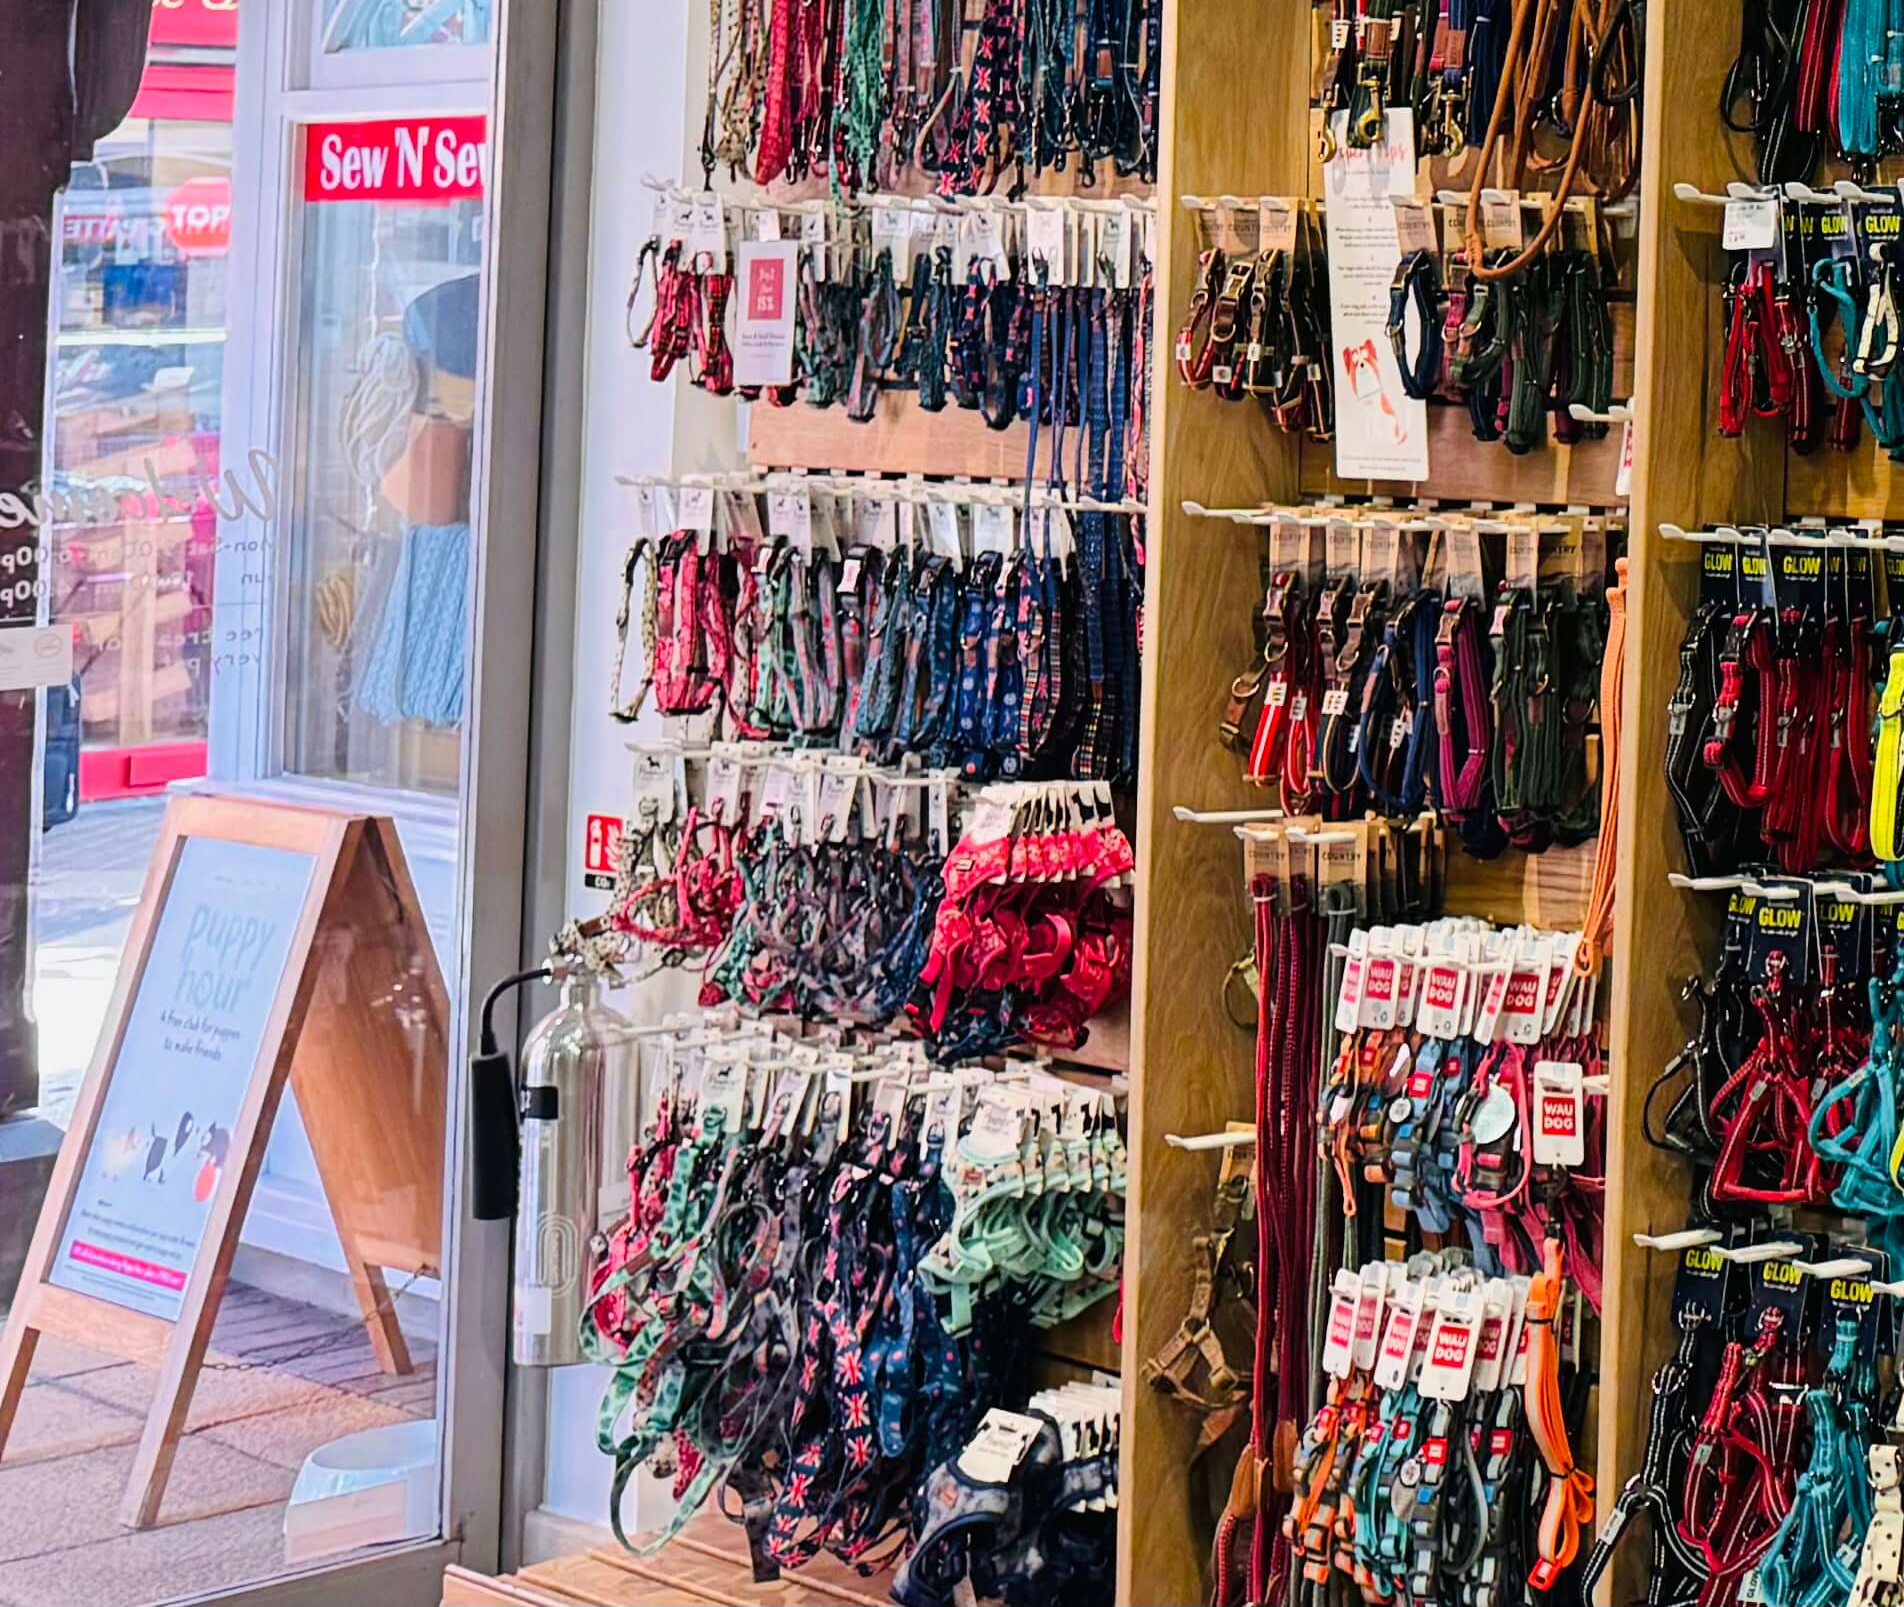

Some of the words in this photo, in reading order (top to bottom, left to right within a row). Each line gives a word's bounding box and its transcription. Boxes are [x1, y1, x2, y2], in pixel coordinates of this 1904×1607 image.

[321, 134, 390, 190] Sew
[1865, 216, 1901, 233] GLOW
[1704, 554, 1733, 571] GLOW
[1783, 556, 1822, 574] GLOW
[1758, 907, 1801, 927] GLOW
[181, 904, 277, 973] puppy
[175, 947, 252, 1012] hour
[1543, 1103, 1575, 1117] WAU
[1543, 1117, 1575, 1130] DOG
[1685, 1249, 1724, 1270] GLOW
[1829, 1280, 1874, 1304] GLOW
[1437, 1332, 1469, 1347] WAU
[1435, 1348, 1465, 1364] DOG
